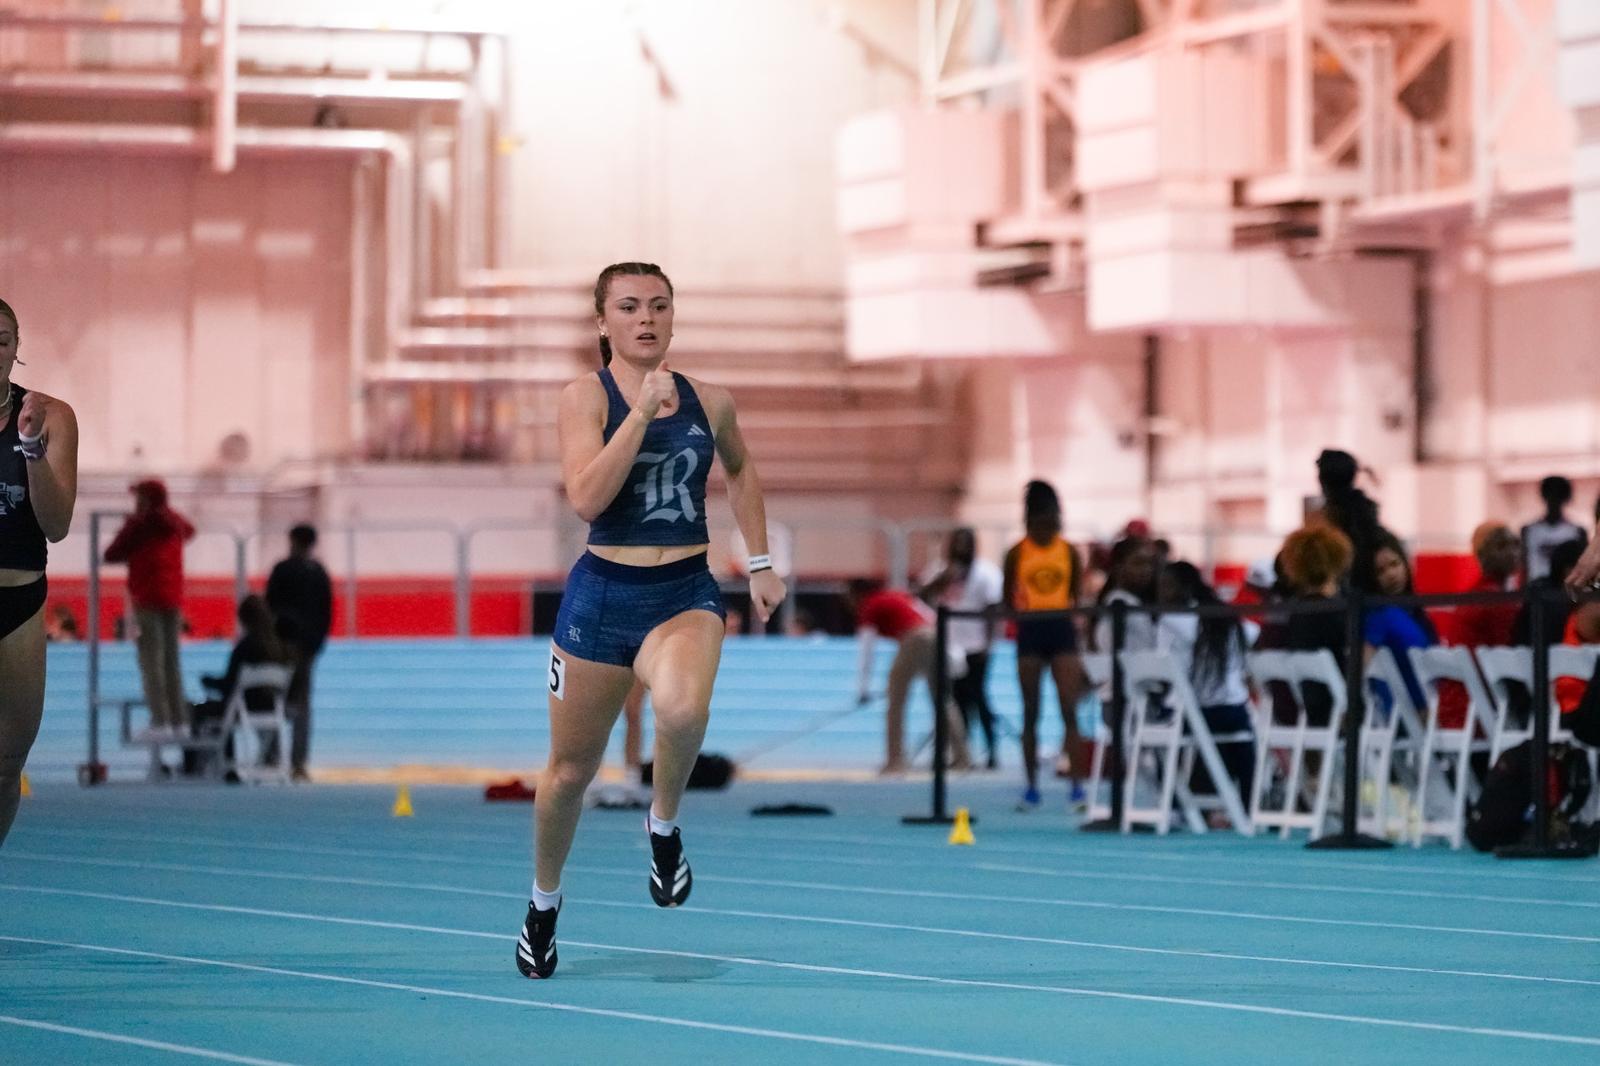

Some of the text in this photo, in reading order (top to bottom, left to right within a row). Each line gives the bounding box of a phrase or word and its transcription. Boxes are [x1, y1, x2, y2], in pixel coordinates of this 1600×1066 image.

[632, 447, 698, 523] R
[568, 625, 581, 643] R
[549, 653, 562, 693] 5
